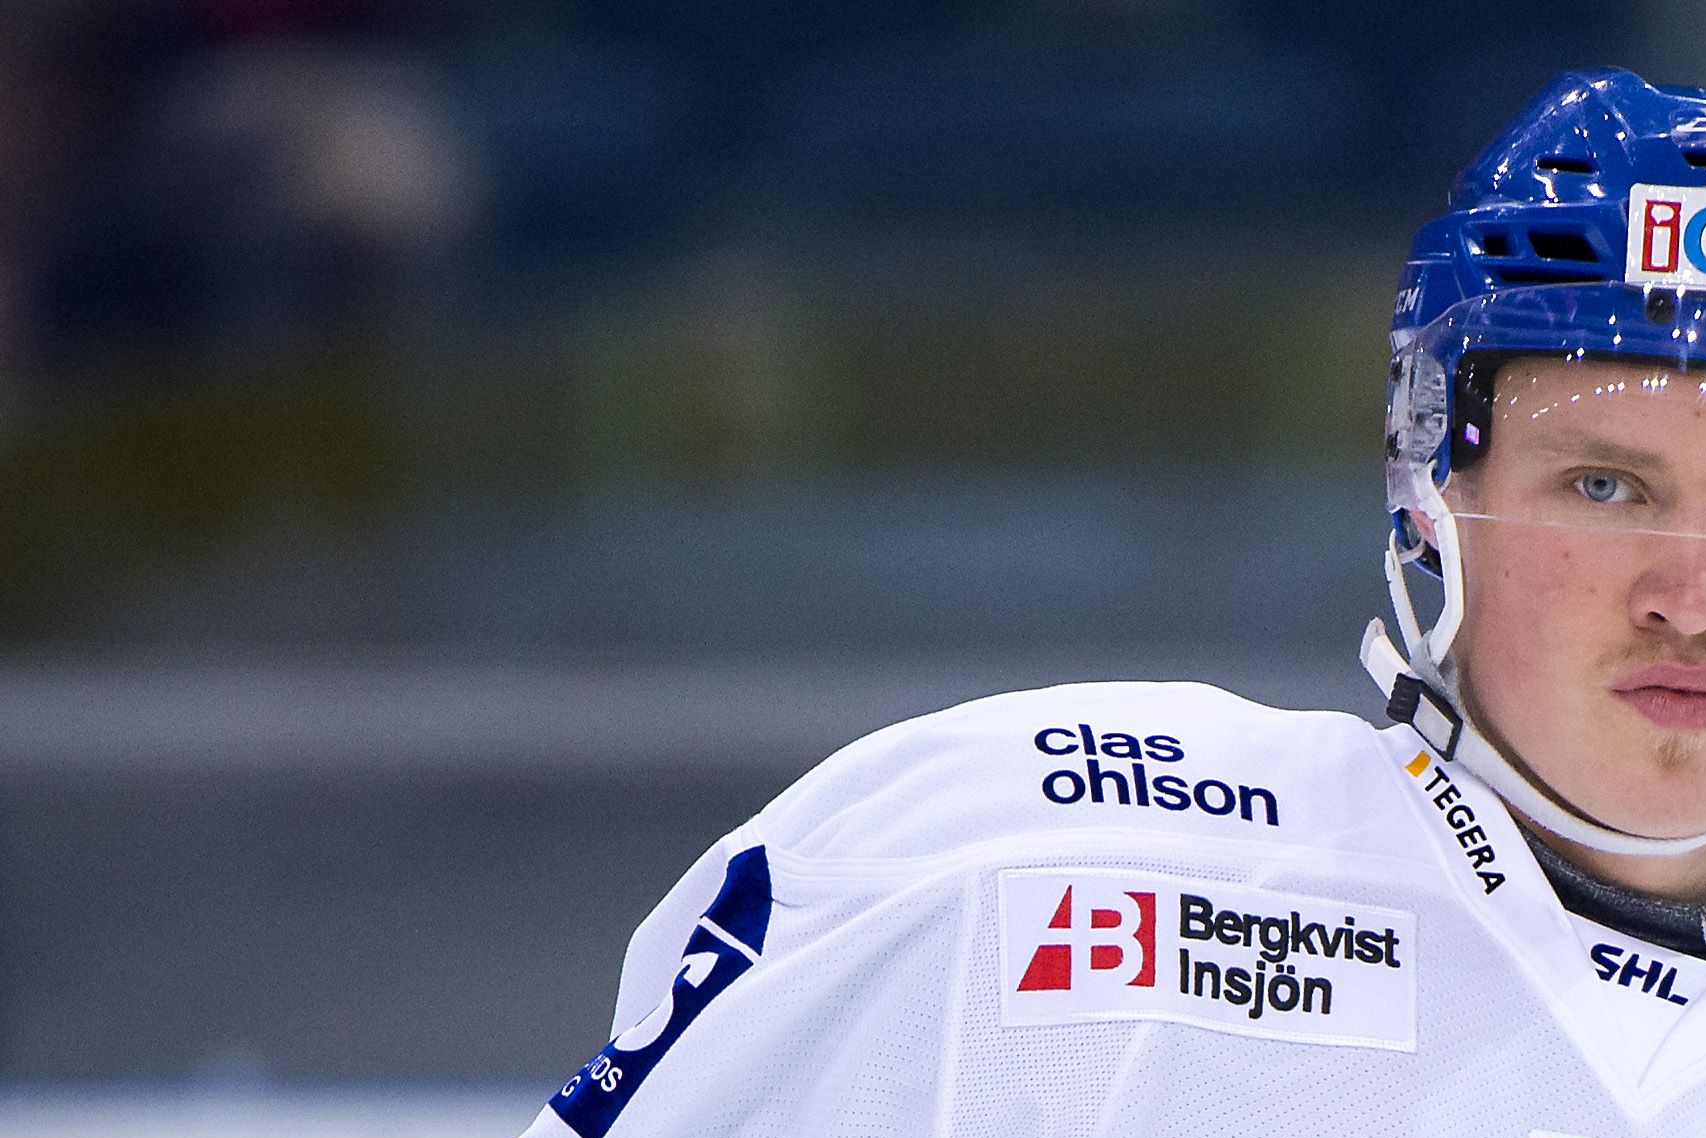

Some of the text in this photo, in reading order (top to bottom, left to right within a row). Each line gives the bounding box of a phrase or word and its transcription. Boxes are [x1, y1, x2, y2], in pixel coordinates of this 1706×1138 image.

[1034, 724, 1184, 763] clas
[1042, 758, 1280, 826] ohlson
[1424, 766, 1506, 896] TEGERA
[1179, 893, 1401, 968] Bergkvist
[1179, 948, 1332, 1019] Insjön
[1590, 943, 1689, 1006] SHL
